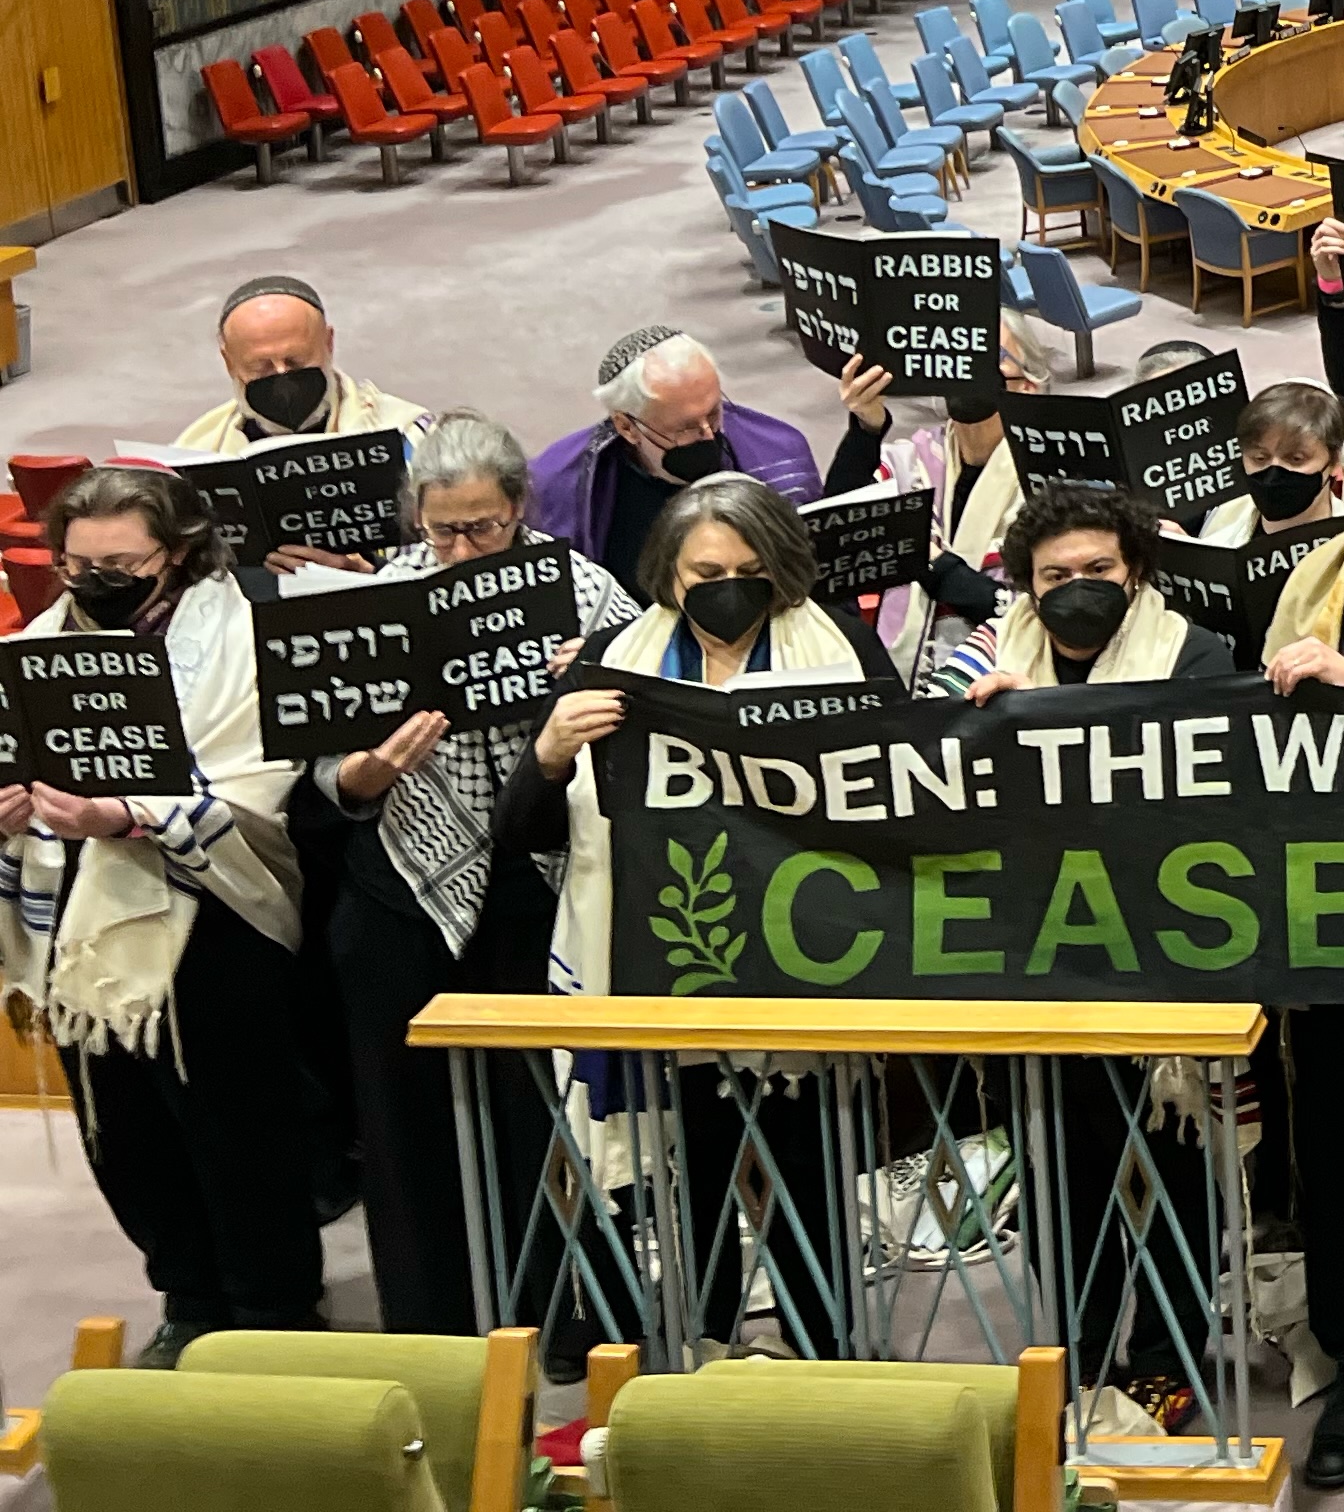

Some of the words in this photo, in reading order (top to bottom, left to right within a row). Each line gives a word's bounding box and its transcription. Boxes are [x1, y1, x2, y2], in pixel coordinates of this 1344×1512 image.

[781, 257, 858, 305] רודפי
[874, 253, 993, 279] RABBIS
[914, 293, 960, 312] FOR
[795, 307, 860, 355] שלום
[886, 325, 988, 352] CEASE
[904, 353, 973, 380] FIRE
[1121, 371, 1237, 427] RABBIS
[1010, 424, 1110, 458] רודפי
[1164, 418, 1210, 445] FOR
[255, 444, 390, 484] RABBIS
[1143, 437, 1243, 490] CEASE
[305, 481, 357, 500] FOR
[1164, 465, 1235, 509] FIRE
[280, 499, 397, 532] CEASE
[803, 496, 924, 535] RABBIS
[305, 522, 385, 548] FIRE
[838, 525, 886, 547] FOR
[815, 538, 916, 580] CEASE
[828, 555, 898, 594] FIRE
[1246, 537, 1333, 581] RAB
[428, 556, 561, 615] RABBIS
[1155, 570, 1232, 611] רודפ
[469, 607, 525, 637] FOR
[266, 623, 410, 668] רודפי
[20, 651, 160, 681] RABBIS
[72, 692, 128, 712] FOR
[276, 676, 411, 726] שלום
[464, 668, 552, 711] FIRE
[738, 694, 883, 727] RABBIS
[45, 724, 170, 754] CEASE
[70, 754, 156, 782] FIRE
[644, 732, 998, 822] BIDEN:
[1016, 715, 1232, 805] THE
